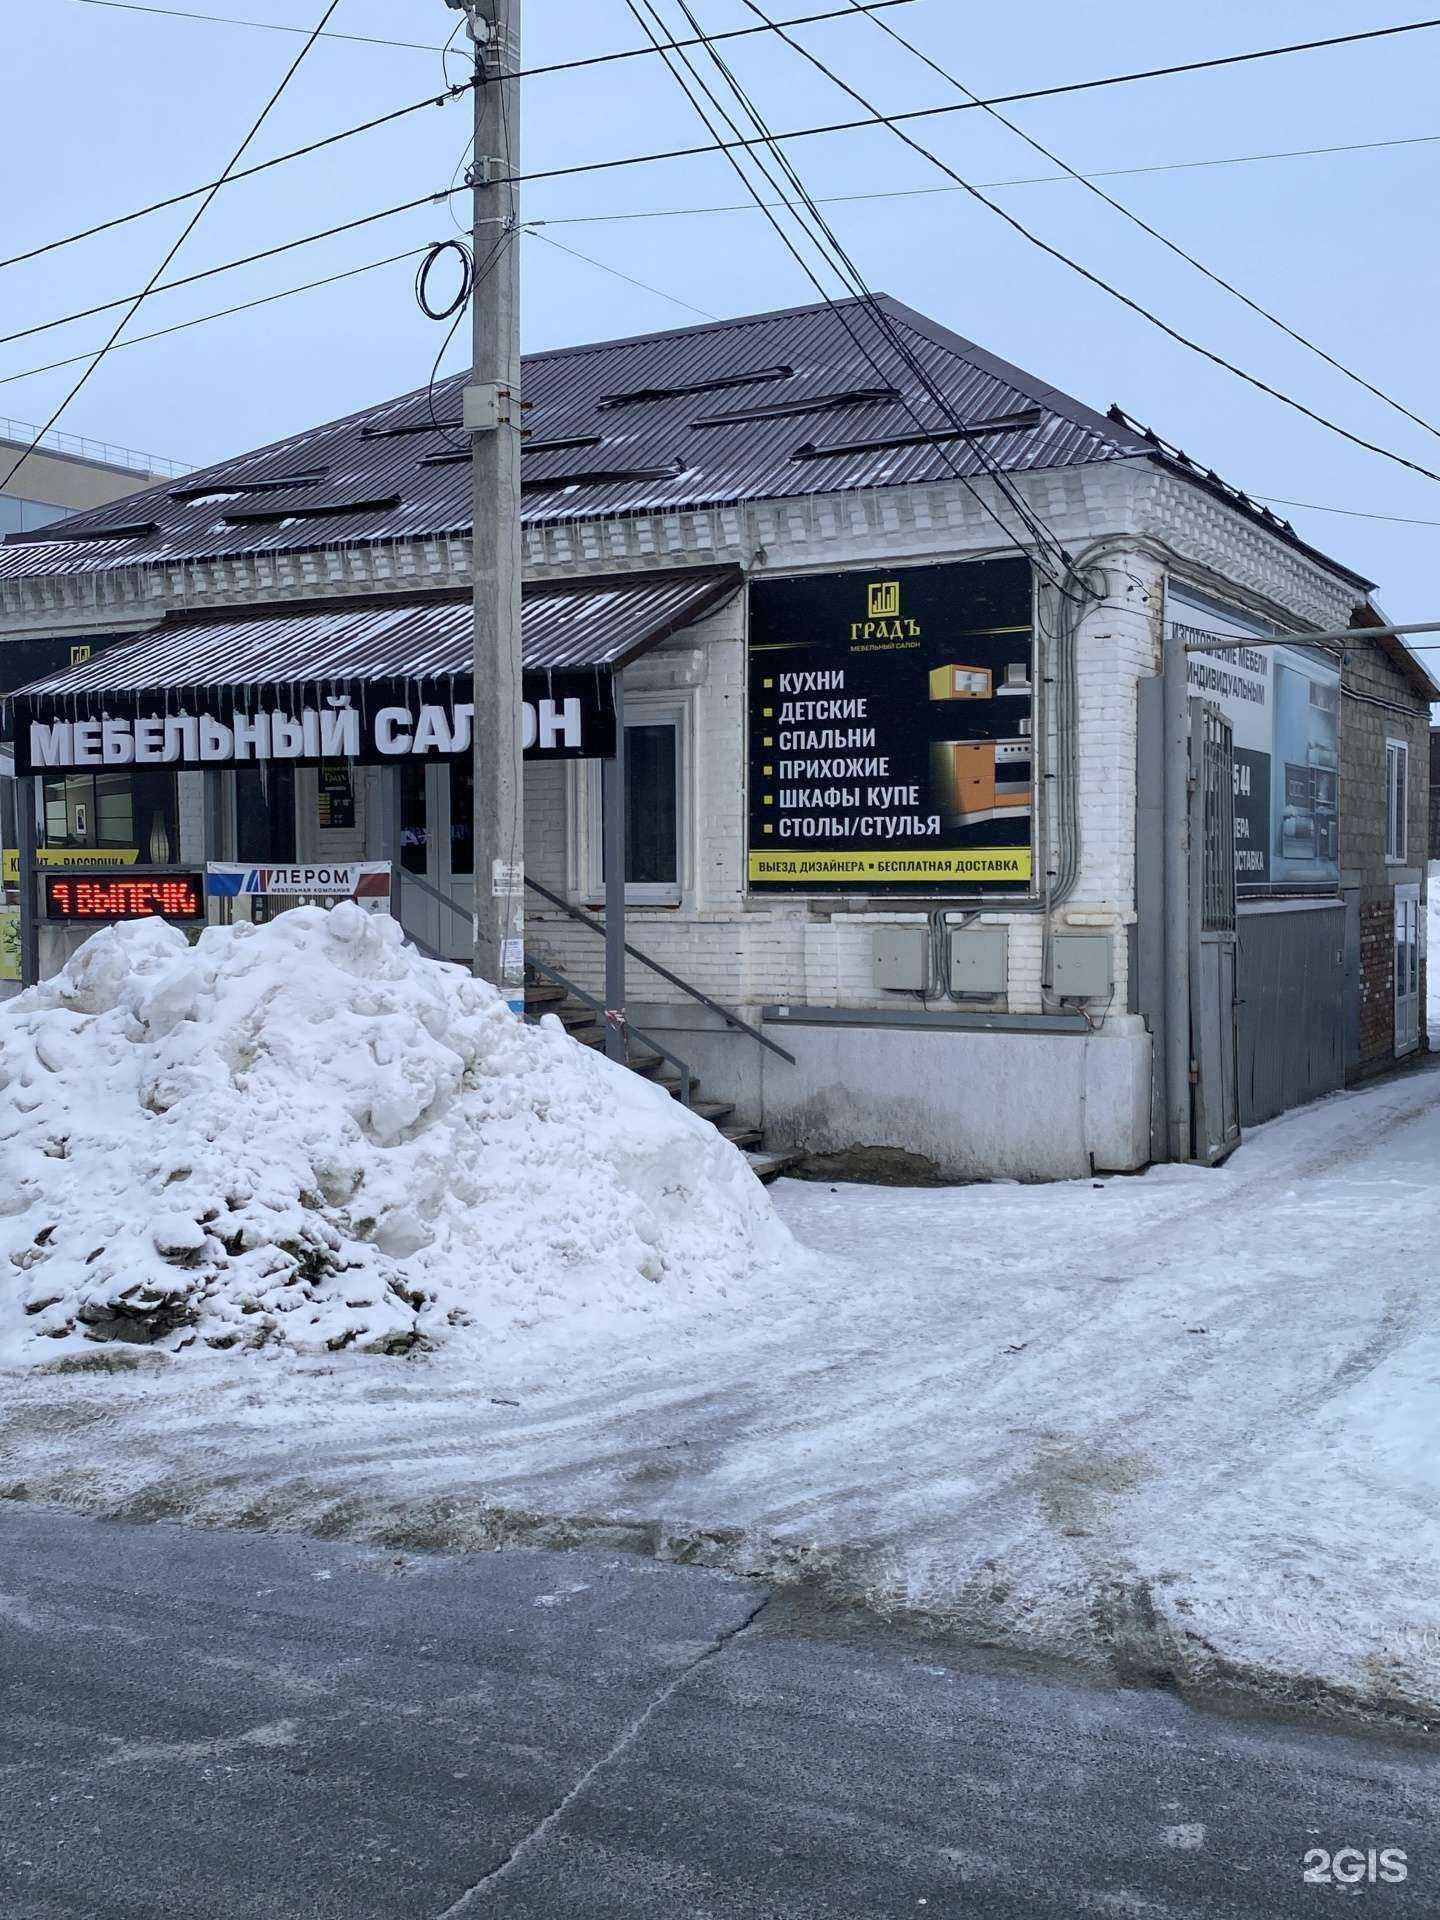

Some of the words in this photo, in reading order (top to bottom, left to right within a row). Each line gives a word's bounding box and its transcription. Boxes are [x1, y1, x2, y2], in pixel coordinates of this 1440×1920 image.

[850, 619, 921, 640] ГРАДЪ
[779, 670, 844, 694] КУХНИ
[779, 699, 867, 724] ДЕТСКИЕ
[30, 695, 360, 767] МЕБЕЛЬНЫЙ
[779, 728, 875, 751] СПАЛЬНИ
[779, 757, 889, 779] ПРИХОЖИЕ
[779, 787, 860, 808] ШКАФЫ
[867, 786, 920, 809] КУПЕ
[779, 815, 941, 838] СТОЛЫ/СТУЛЬЯ
[274, 869, 349, 884] ЛЕРОМ
[758, 861, 797, 874] ВЫЕЗД
[800, 860, 865, 873] ДИЗАЙНЕРА
[877, 860, 952, 873] БЕСПЛАТНАЯ
[955, 859, 1019, 874] ДОСТАВКА
